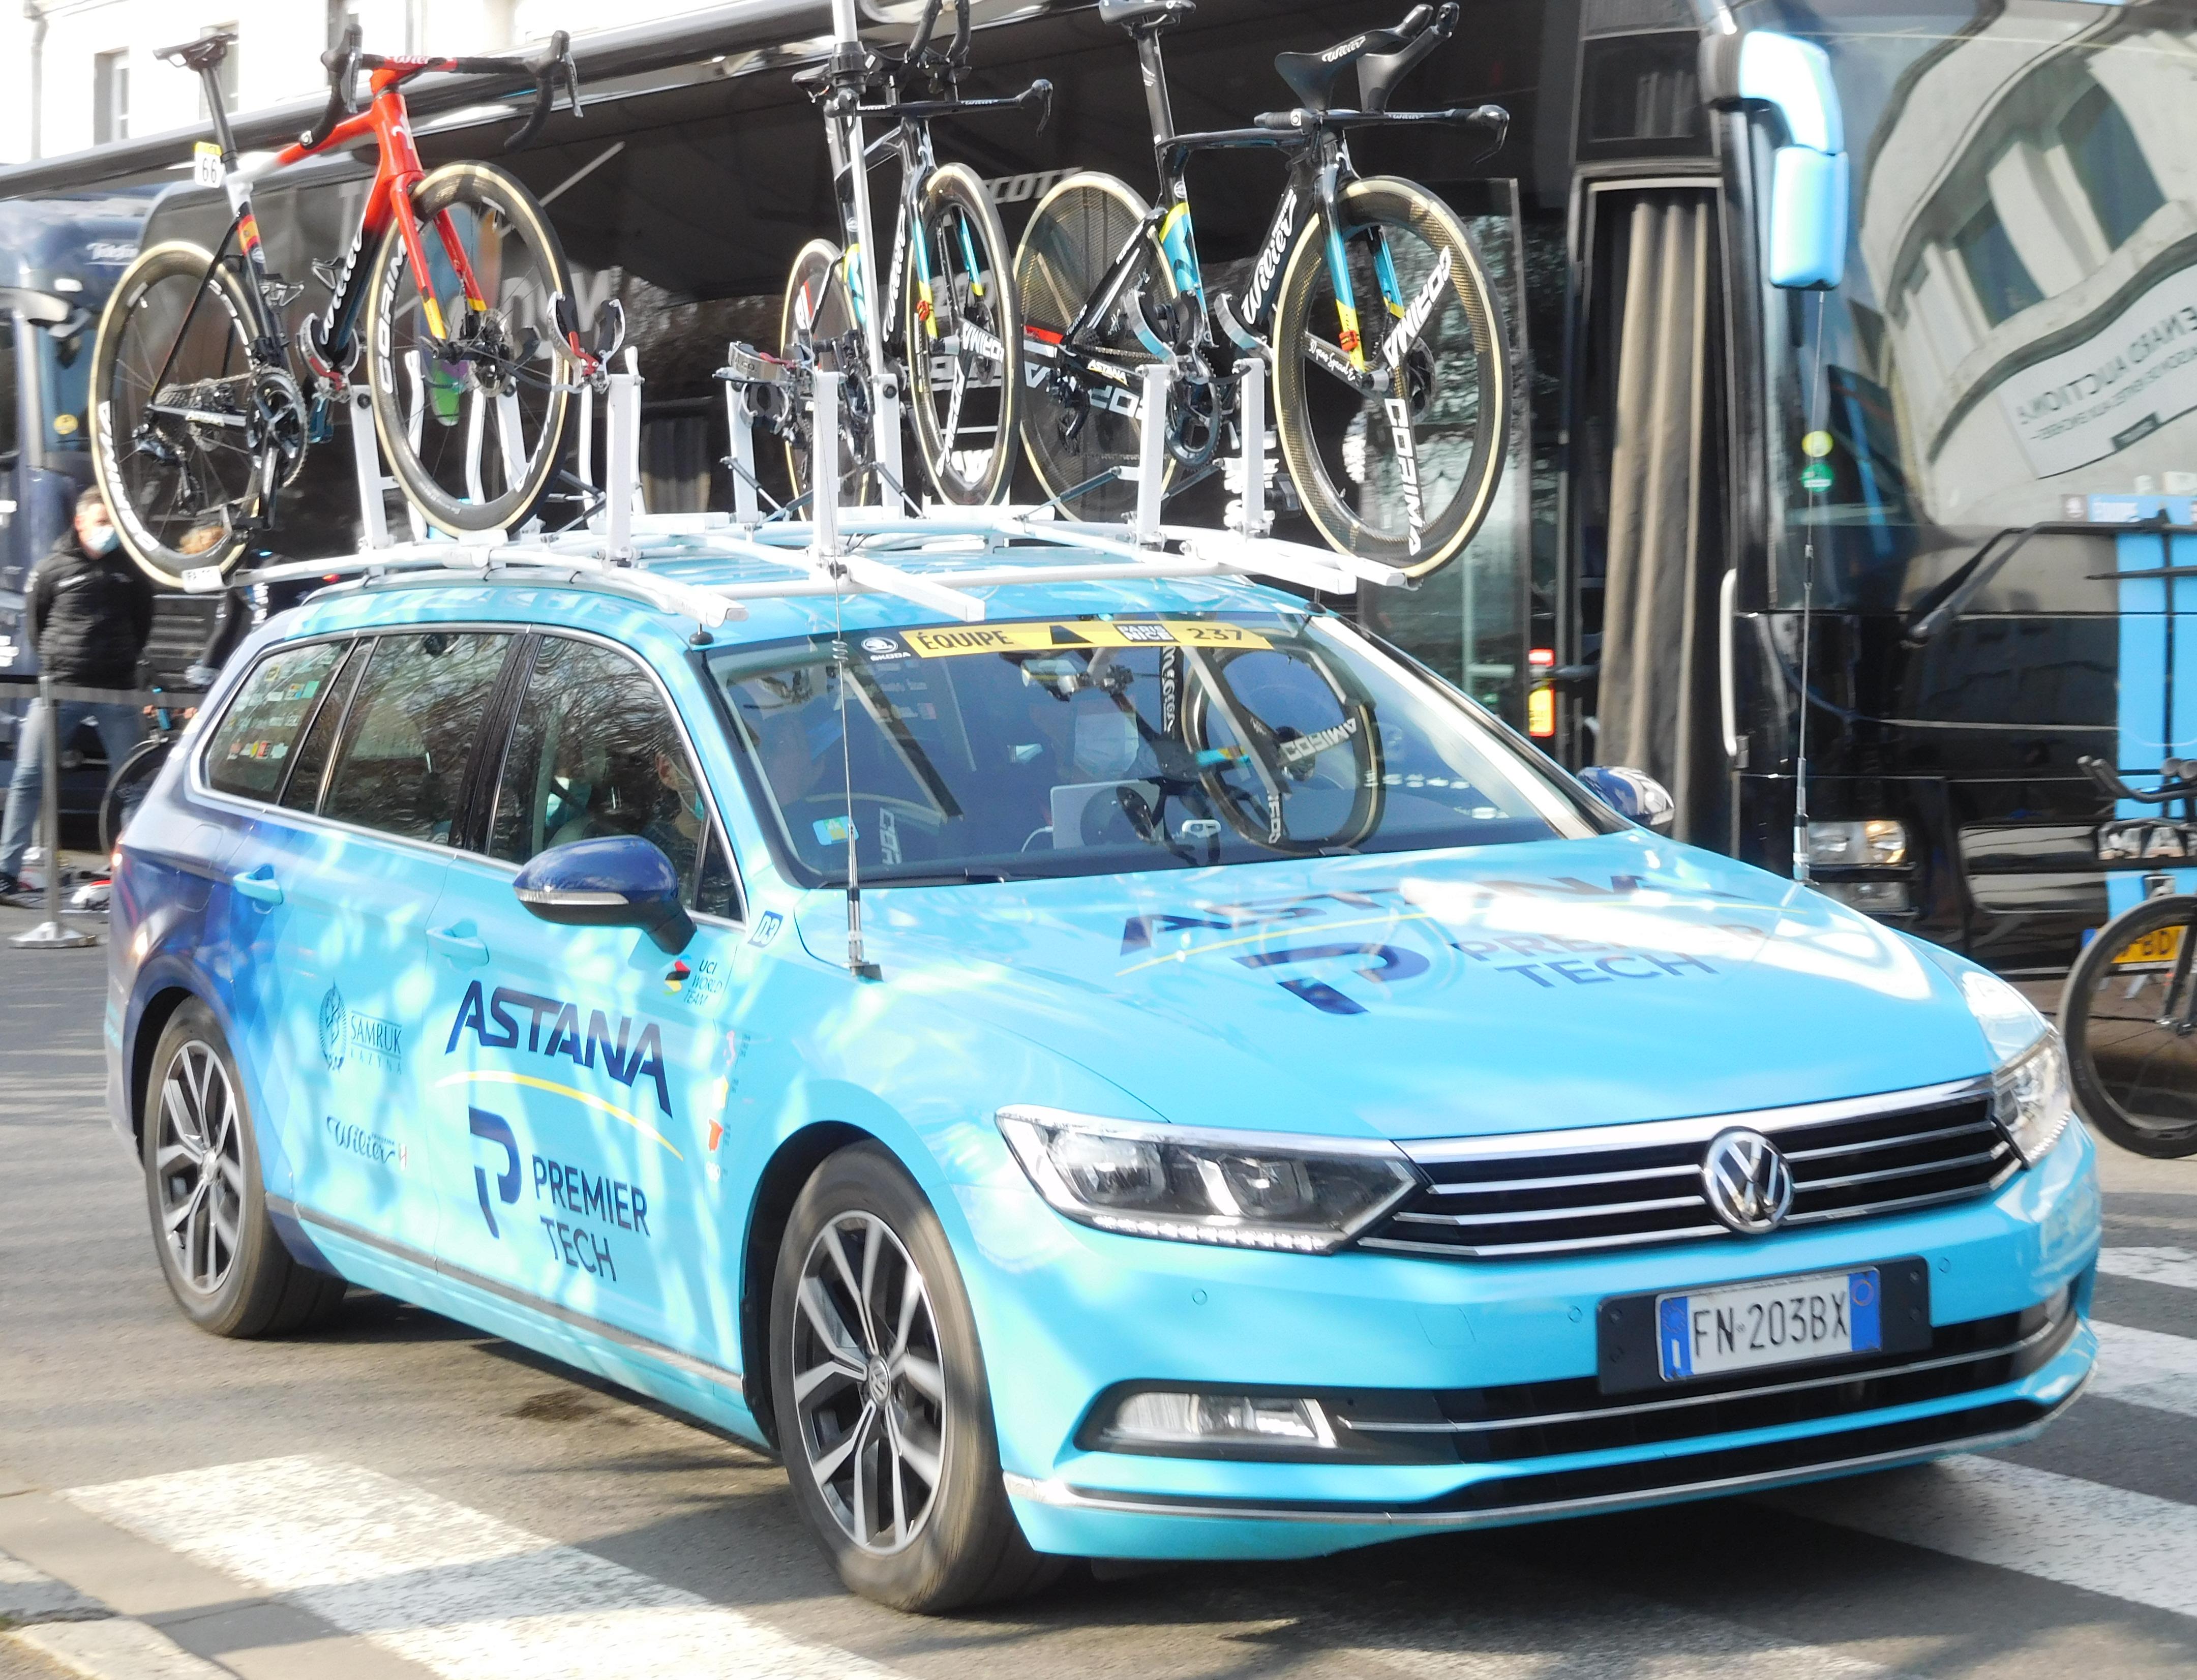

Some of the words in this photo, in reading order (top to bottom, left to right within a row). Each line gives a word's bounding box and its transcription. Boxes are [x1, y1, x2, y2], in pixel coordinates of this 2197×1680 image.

[202, 157, 217, 184] 66
[1241, 194, 1298, 325] Wilier
[1382, 245, 1452, 370] CORIMA
[1384, 398, 1427, 556] CORIMA
[916, 631, 1014, 650] ÉQUIPE
[1186, 627, 1242, 641] 237
[691, 975, 723, 993] WORLD
[699, 959, 718, 975] UCI
[1494, 950, 1720, 988] TECH
[683, 989, 708, 1006] TEAM
[351, 1015, 402, 1055] SAMRUK
[444, 980, 673, 1120] ASTANA
[326, 1116, 396, 1164] Wilier
[532, 1154, 651, 1238] PREMIER
[540, 1214, 617, 1282] TECH
